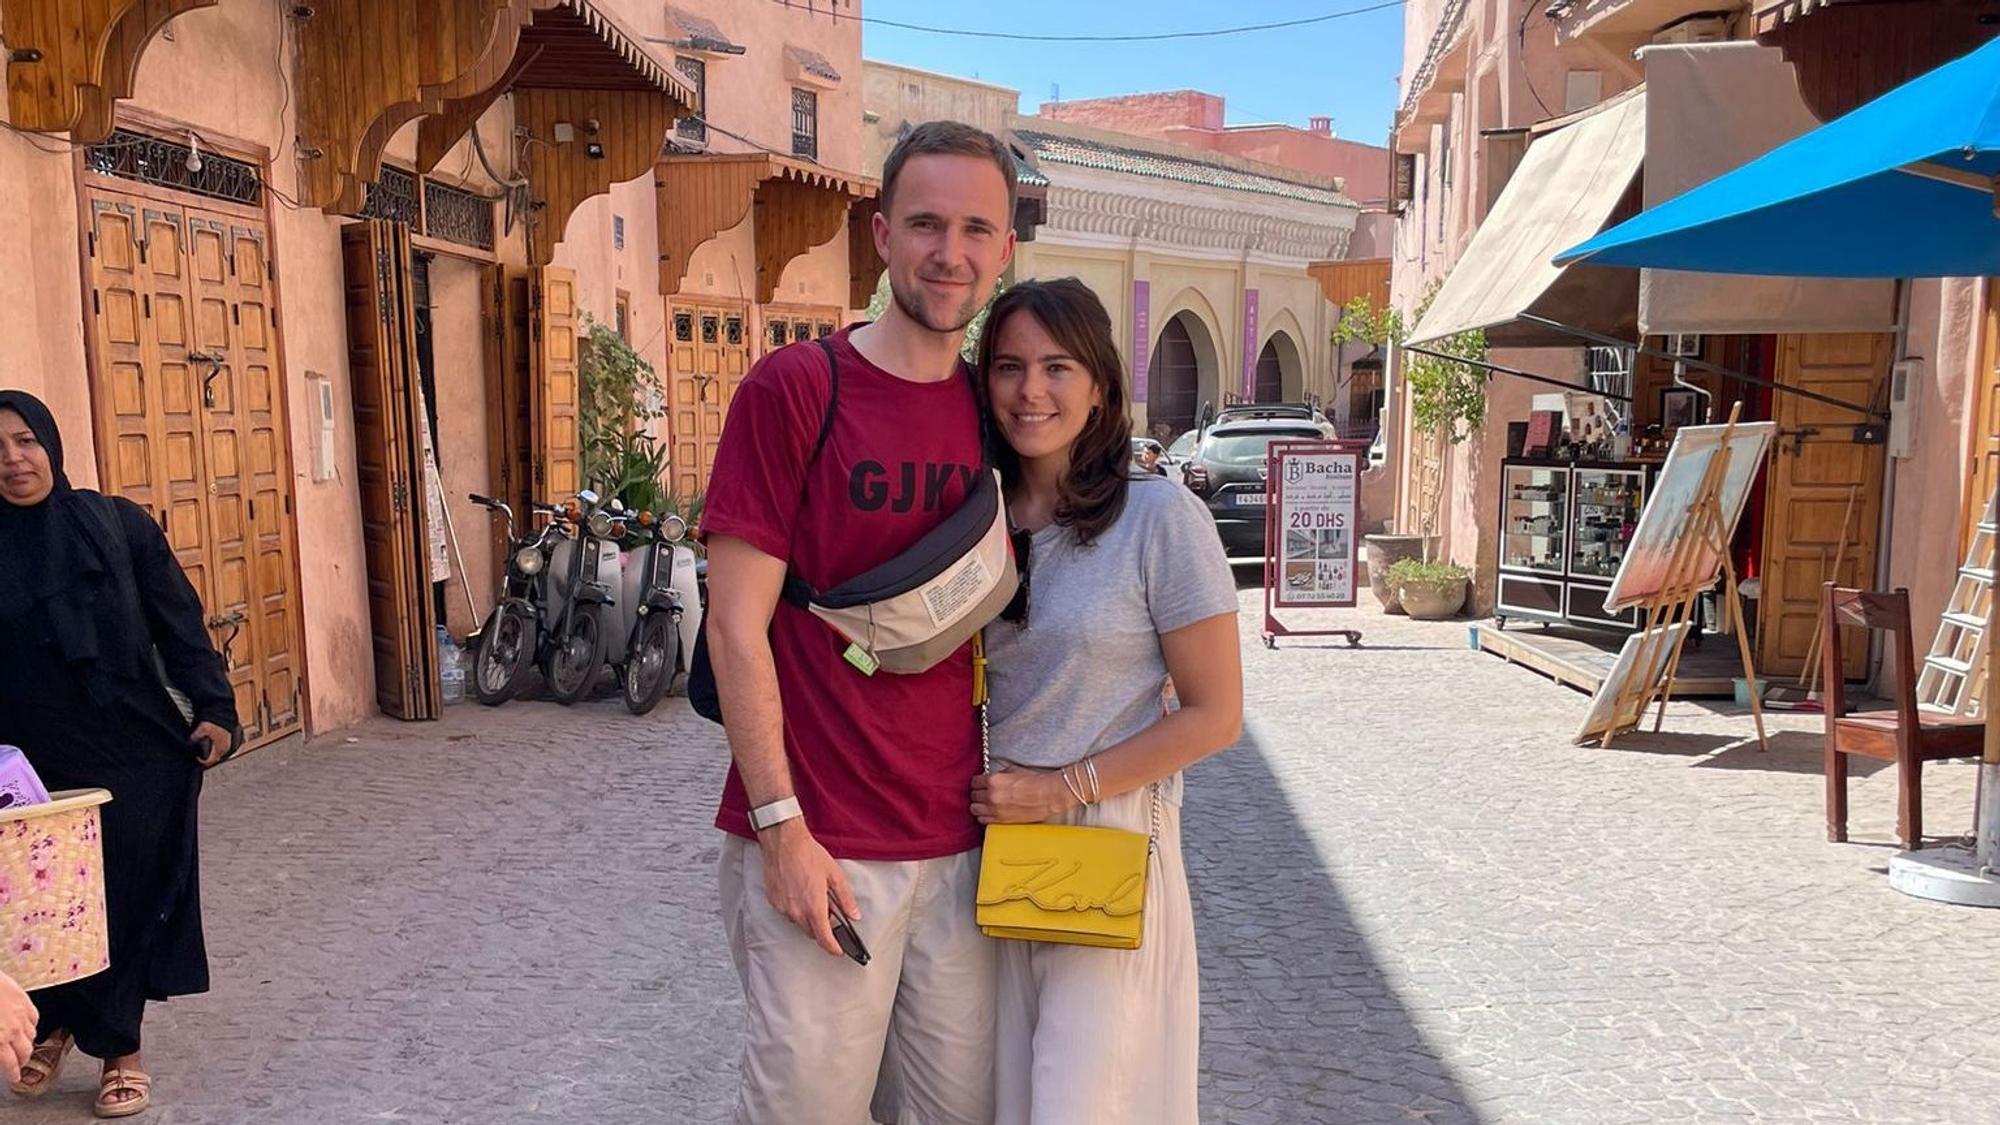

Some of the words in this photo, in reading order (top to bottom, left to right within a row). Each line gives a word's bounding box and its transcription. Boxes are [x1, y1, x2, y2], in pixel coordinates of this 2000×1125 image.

[1289, 465, 1300, 480] B
[1305, 461, 1353, 474] Bacha
[1290, 511, 1312, 528] 20
[1316, 512, 1345, 528] DHS
